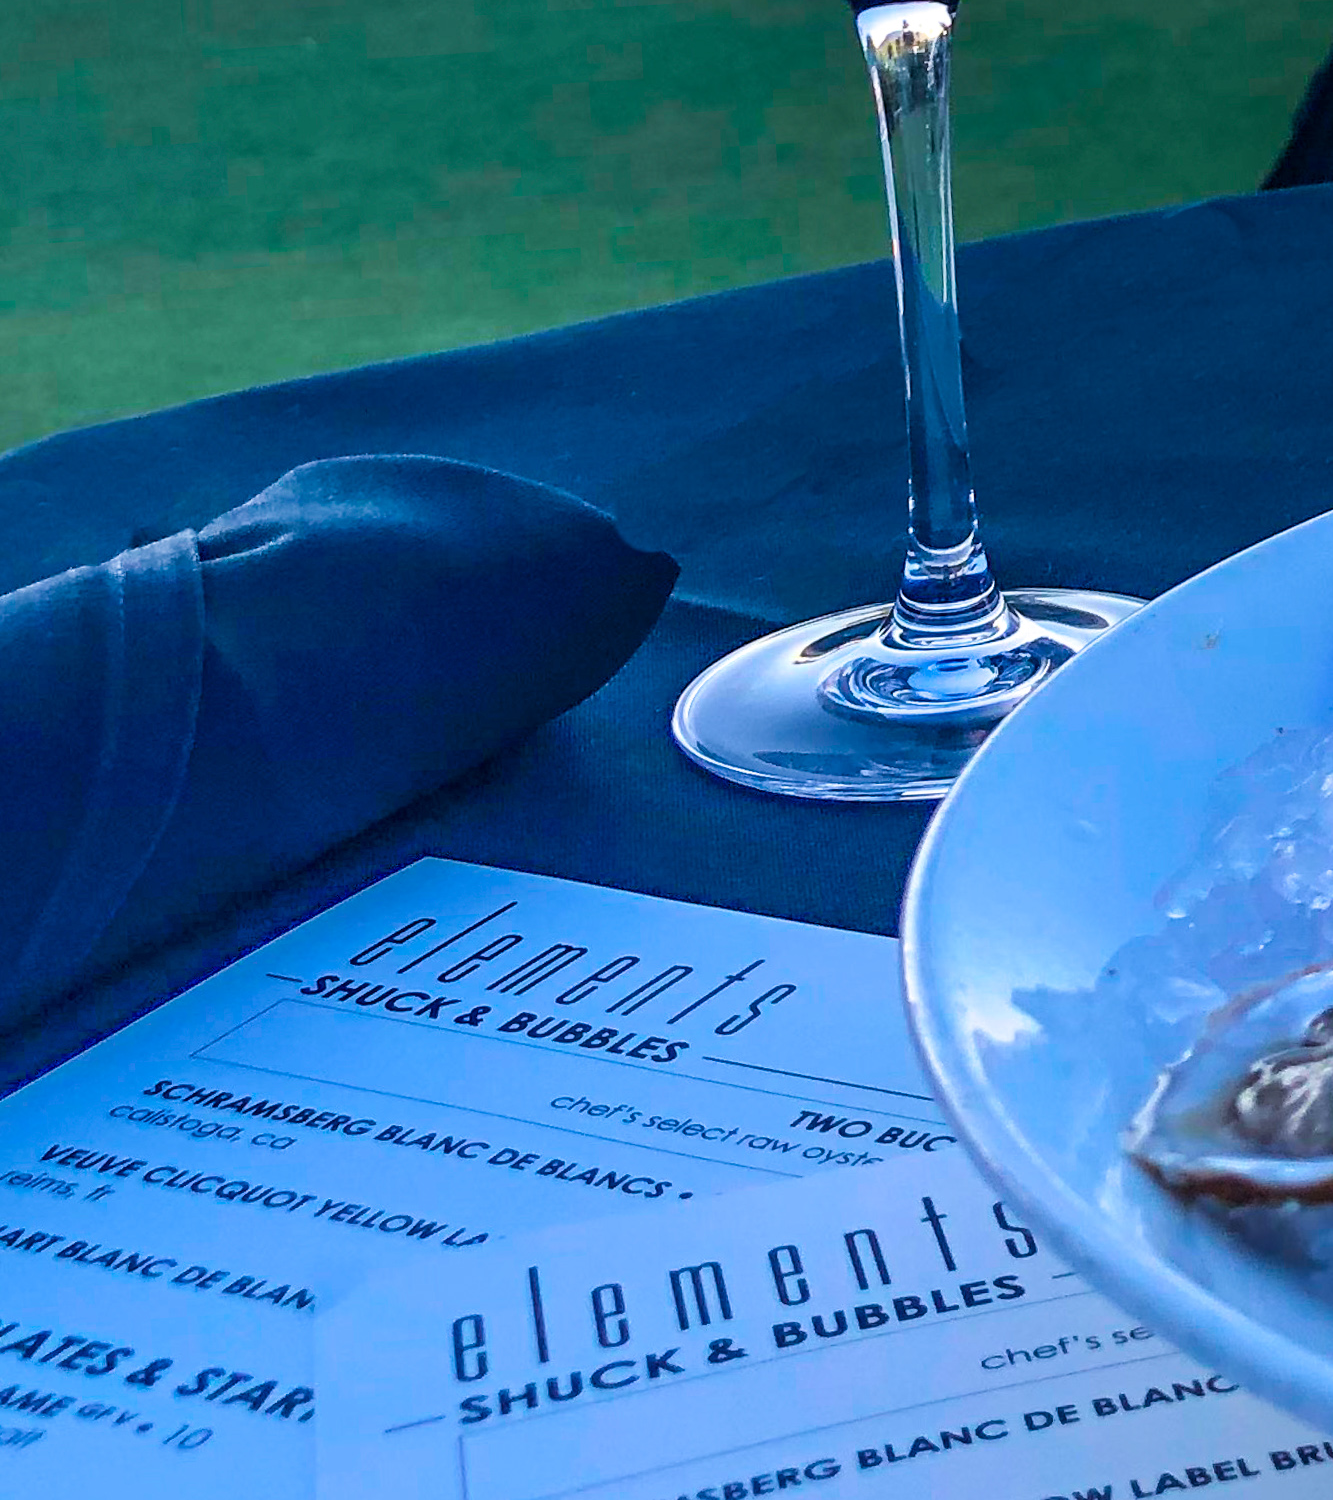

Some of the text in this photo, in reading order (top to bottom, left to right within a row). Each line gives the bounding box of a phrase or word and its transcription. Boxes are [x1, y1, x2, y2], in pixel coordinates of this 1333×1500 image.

[350, 901, 797, 1036] elements
[300, 974, 691, 1064] SHUCK & BUBBLES
[109, 1105, 298, 1150] calistoga, ca
[143, 1080, 672, 1199] SCHRAMSBERG BLANC DE BLANCS
[551, 1095, 639, 1126] chef's
[642, 1113, 739, 1143] select
[736, 1133, 802, 1153] raw
[790, 1110, 873, 1138] TWO
[40, 1144, 148, 1177] VEUVE
[143, 1165, 317, 1211] CLICQUOT
[314, 1198, 447, 1238] YELLOW
[56, 1240, 178, 1277] BLANC
[171, 1265, 231, 1289] DE
[451, 1196, 1038, 1381] elements
[126, 1357, 173, 1386] &
[458, 1275, 1026, 1426] SHUCK & BUBBLES
[980, 1334, 1101, 1371] chef's
[161, 1424, 214, 1450] 10
[856, 1419, 1009, 1469] BLANC
[1023, 1404, 1081, 1432] DE
[1092, 1374, 1241, 1418] BLANC
[1130, 1457, 1261, 1500] LABEL
